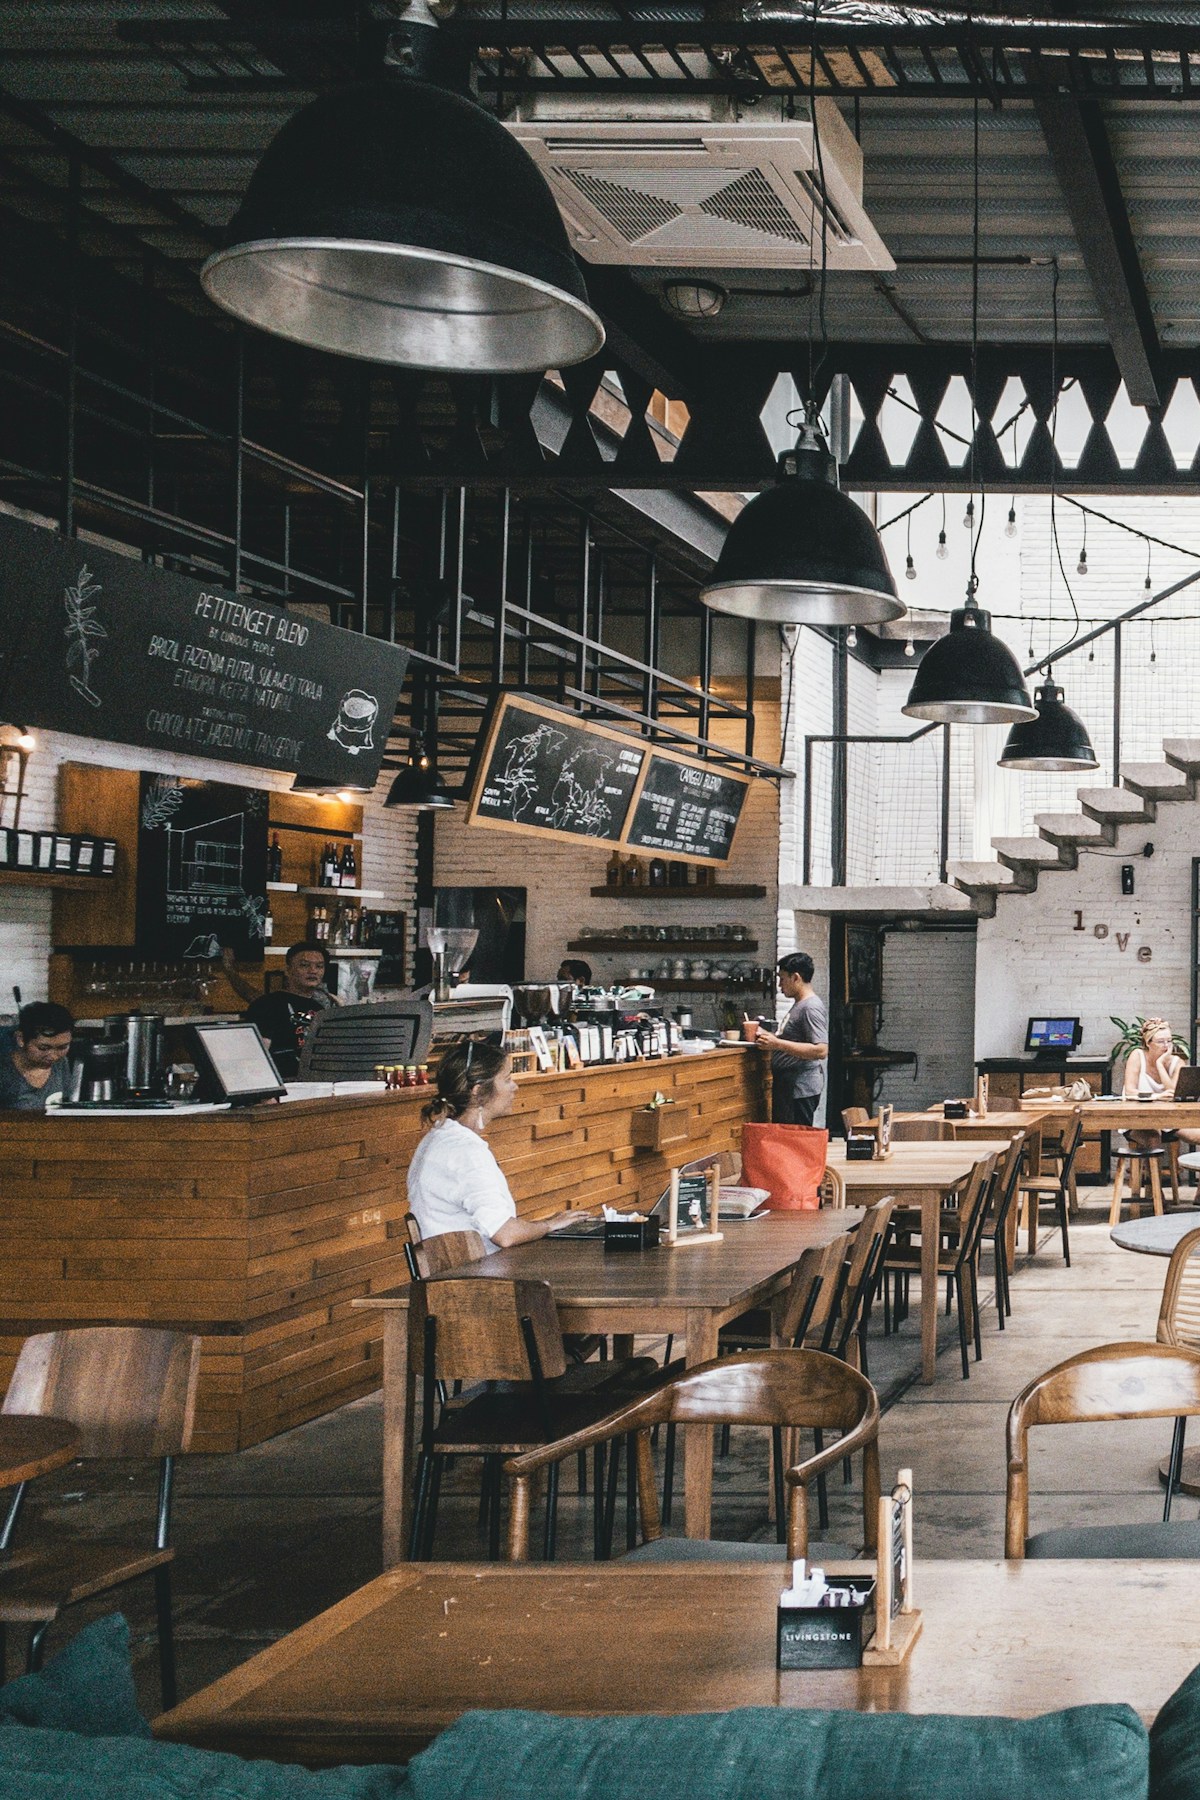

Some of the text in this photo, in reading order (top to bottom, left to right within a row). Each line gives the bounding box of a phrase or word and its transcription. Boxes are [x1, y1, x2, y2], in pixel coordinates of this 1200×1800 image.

[195, 592, 309, 647] PETITENGET BLEND
[148, 635, 180, 662] BRAZIL
[182, 644, 225, 674] FAZENDA
[252, 640, 275, 657] PEOPLE
[1073, 910, 1152, 963] love
[785, 1632, 852, 1641] LIVINGSTONE
